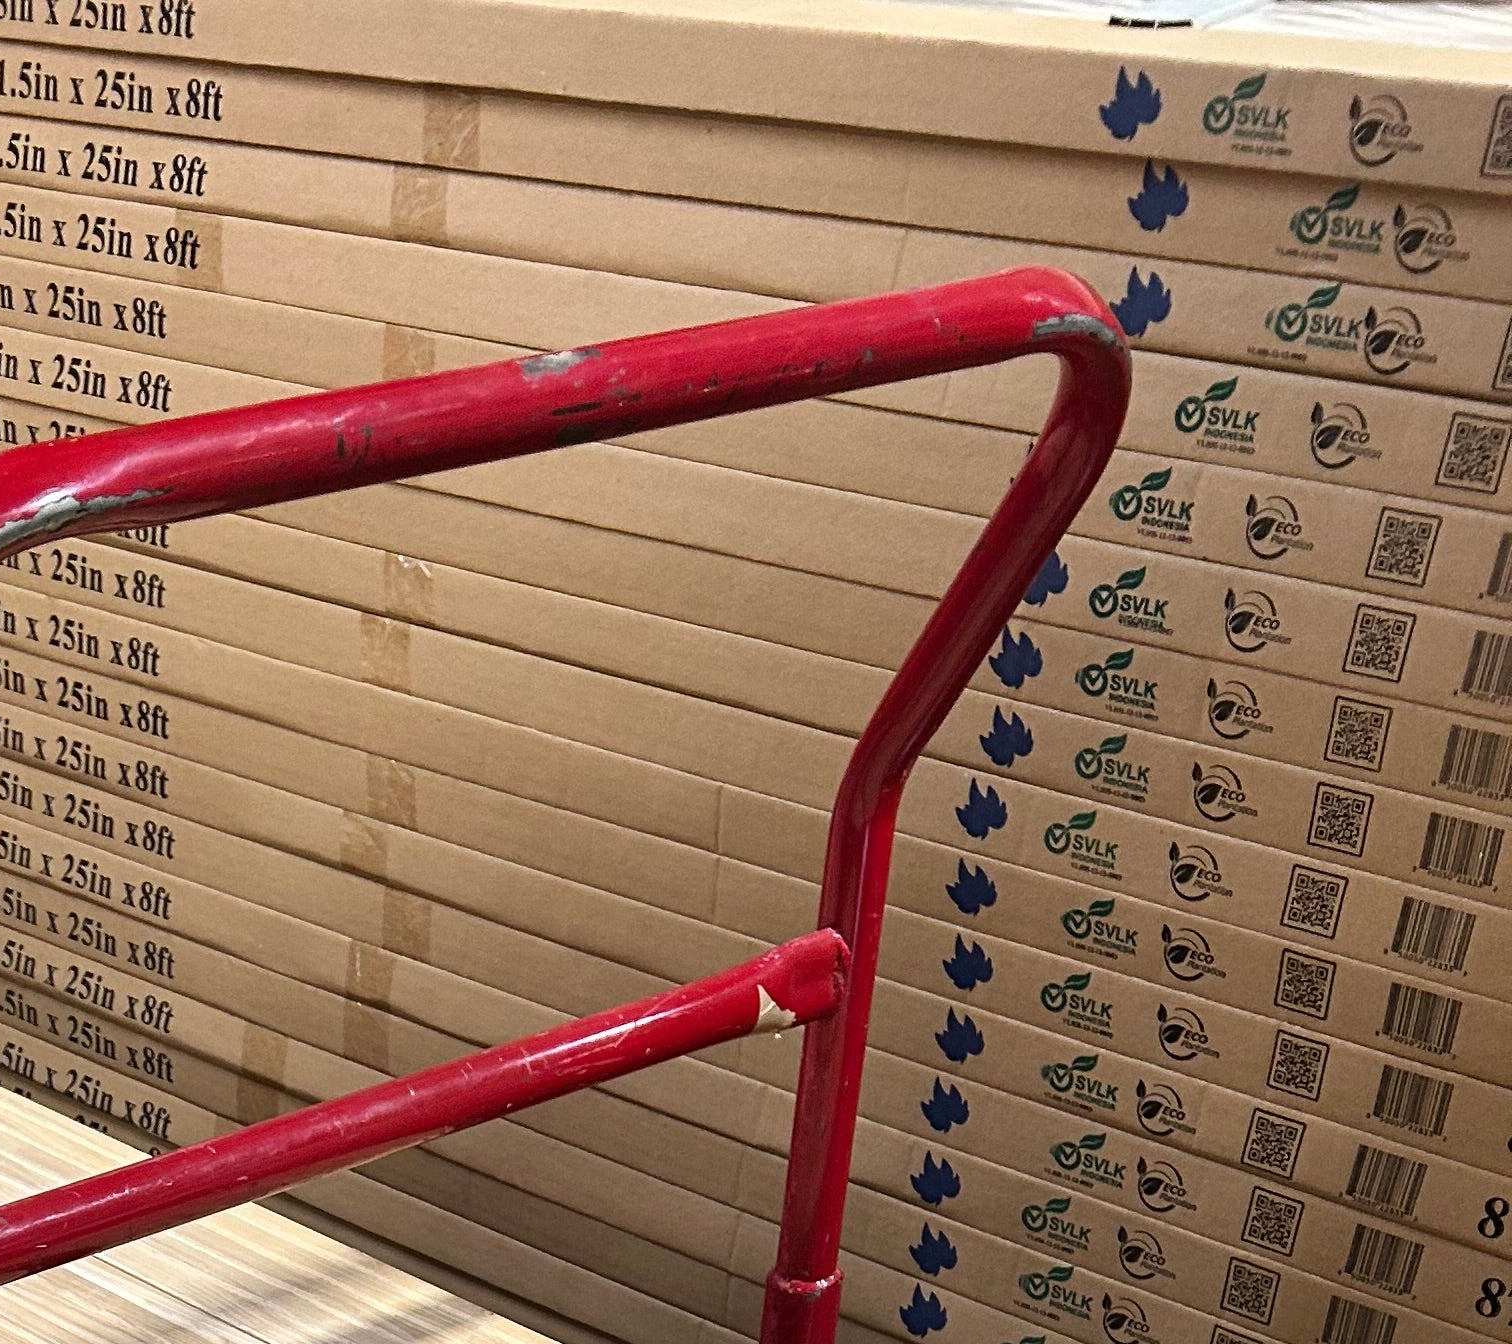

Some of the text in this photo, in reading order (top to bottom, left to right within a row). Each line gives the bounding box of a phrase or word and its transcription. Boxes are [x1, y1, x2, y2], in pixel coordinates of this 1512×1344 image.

[69, 77, 85, 106] x
[94, 68, 154, 114] 25in
[56, 149, 72, 178] x
[81, 142, 138, 187] 25in
[51, 219, 67, 247] x
[75, 213, 133, 259] 25in
[22, 288, 39, 315] x
[46, 282, 103, 327] 25in
[27, 359, 43, 386] x
[50, 353, 107, 400] 25in
[1207, 406, 1260, 432] SVLK
[1143, 496, 1194, 522] SVLK
[1275, 521, 1302, 536] ECO
[29, 551, 43, 577] x
[50, 548, 104, 594] 25in
[1119, 594, 1169, 619] SVLK
[1253, 616, 1280, 630] ECO
[25, 616, 40, 642] x
[48, 614, 100, 660] 25in
[34, 677, 49, 703] x
[55, 676, 110, 722] 25in
[1109, 675, 1158, 699] SVLK
[1235, 705, 1261, 719] ECO
[33, 736, 47, 762] x
[55, 735, 108, 781] 25in
[41, 793, 55, 818] x
[63, 793, 115, 840] 25in
[1072, 834, 1118, 860] SVLK
[39, 853, 54, 878] x
[60, 853, 112, 900] 25in
[1196, 869, 1221, 883] ECO
[46, 910, 60, 935] x
[67, 911, 118, 958] 25in
[1093, 920, 1138, 947] SVLK
[43, 963, 59, 988] x
[63, 965, 115, 1011] 25in
[1069, 995, 1112, 1020] SVLK
[46, 1013, 60, 1036] x
[67, 1015, 117, 1061] 25in
[64, 1069, 113, 1115] 25in
[1074, 1075, 1119, 1102] SVLK
[1082, 1154, 1126, 1181] SVLK
[1162, 1183, 1186, 1198] ECO
[1051, 1285, 1093, 1311] SVLK
